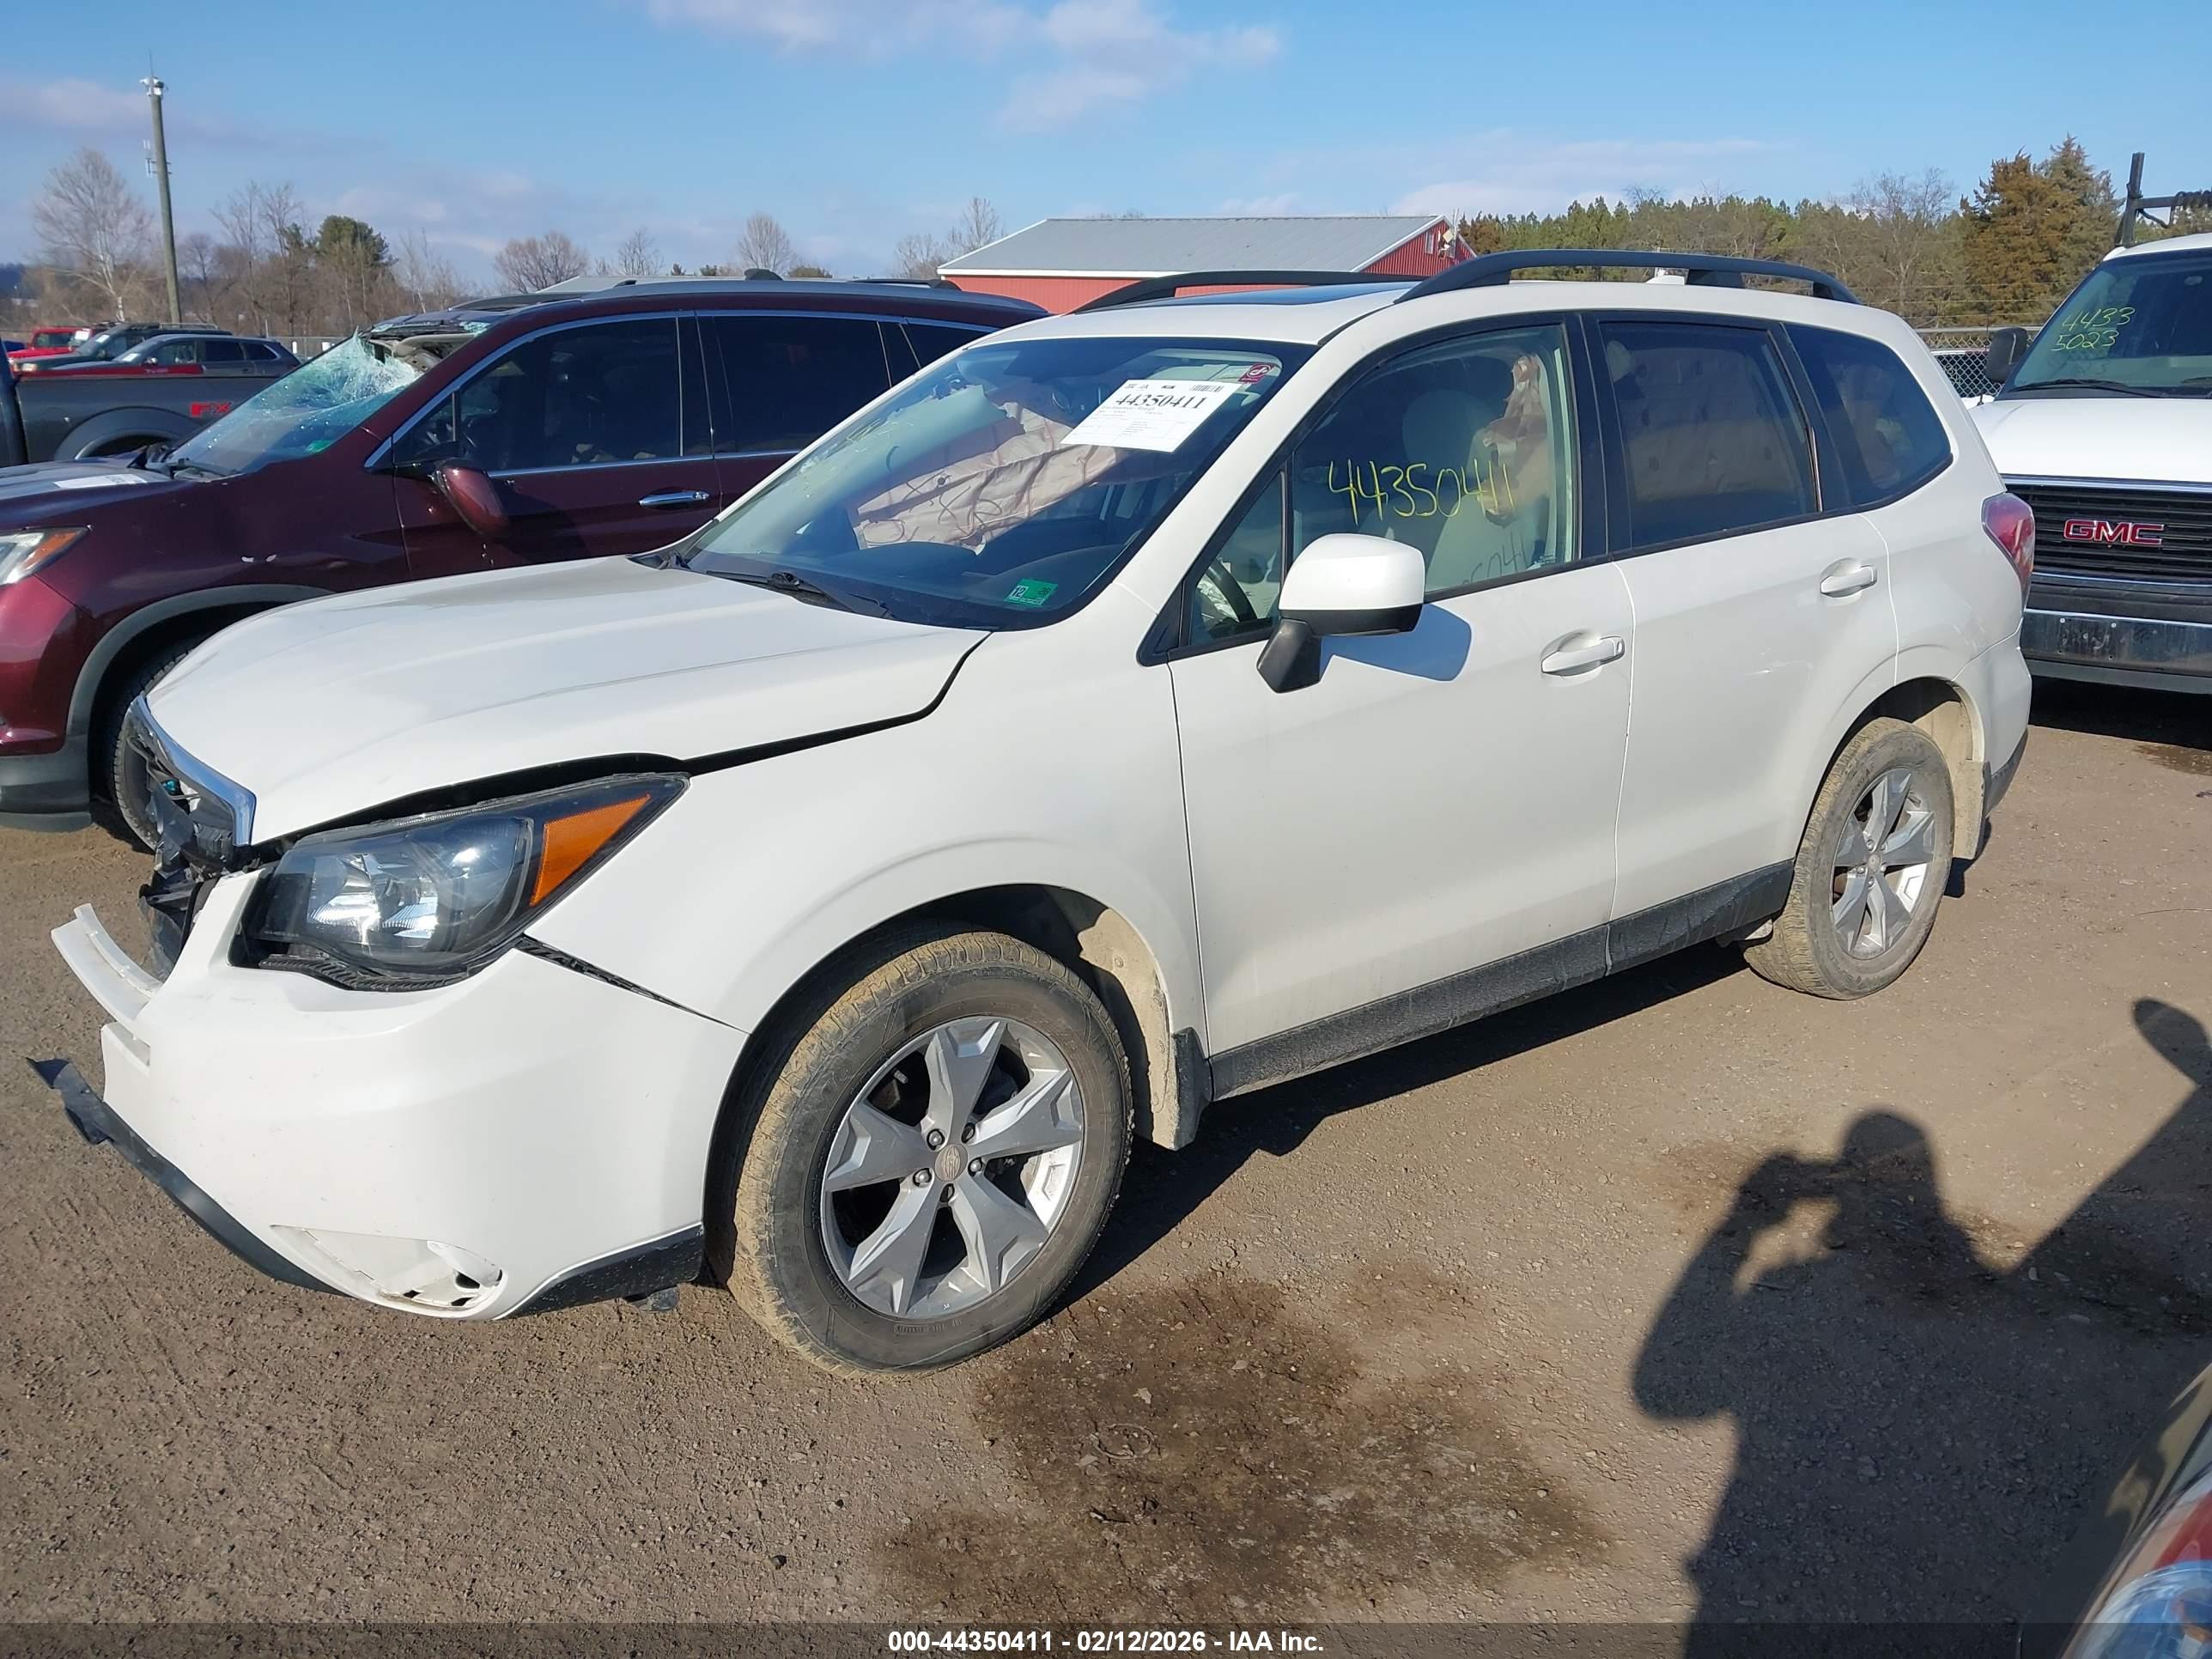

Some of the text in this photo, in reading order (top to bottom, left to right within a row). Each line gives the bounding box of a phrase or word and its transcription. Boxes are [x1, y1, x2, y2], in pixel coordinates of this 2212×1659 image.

[2063, 307, 2136, 331] 4433
[2051, 330, 2120, 351] 5023
[1115, 393, 1207, 410] 44350411
[1328, 459, 1515, 526] 44350411
[2063, 519, 2165, 545] GMC
[1012, 586, 1026, 598] 12
